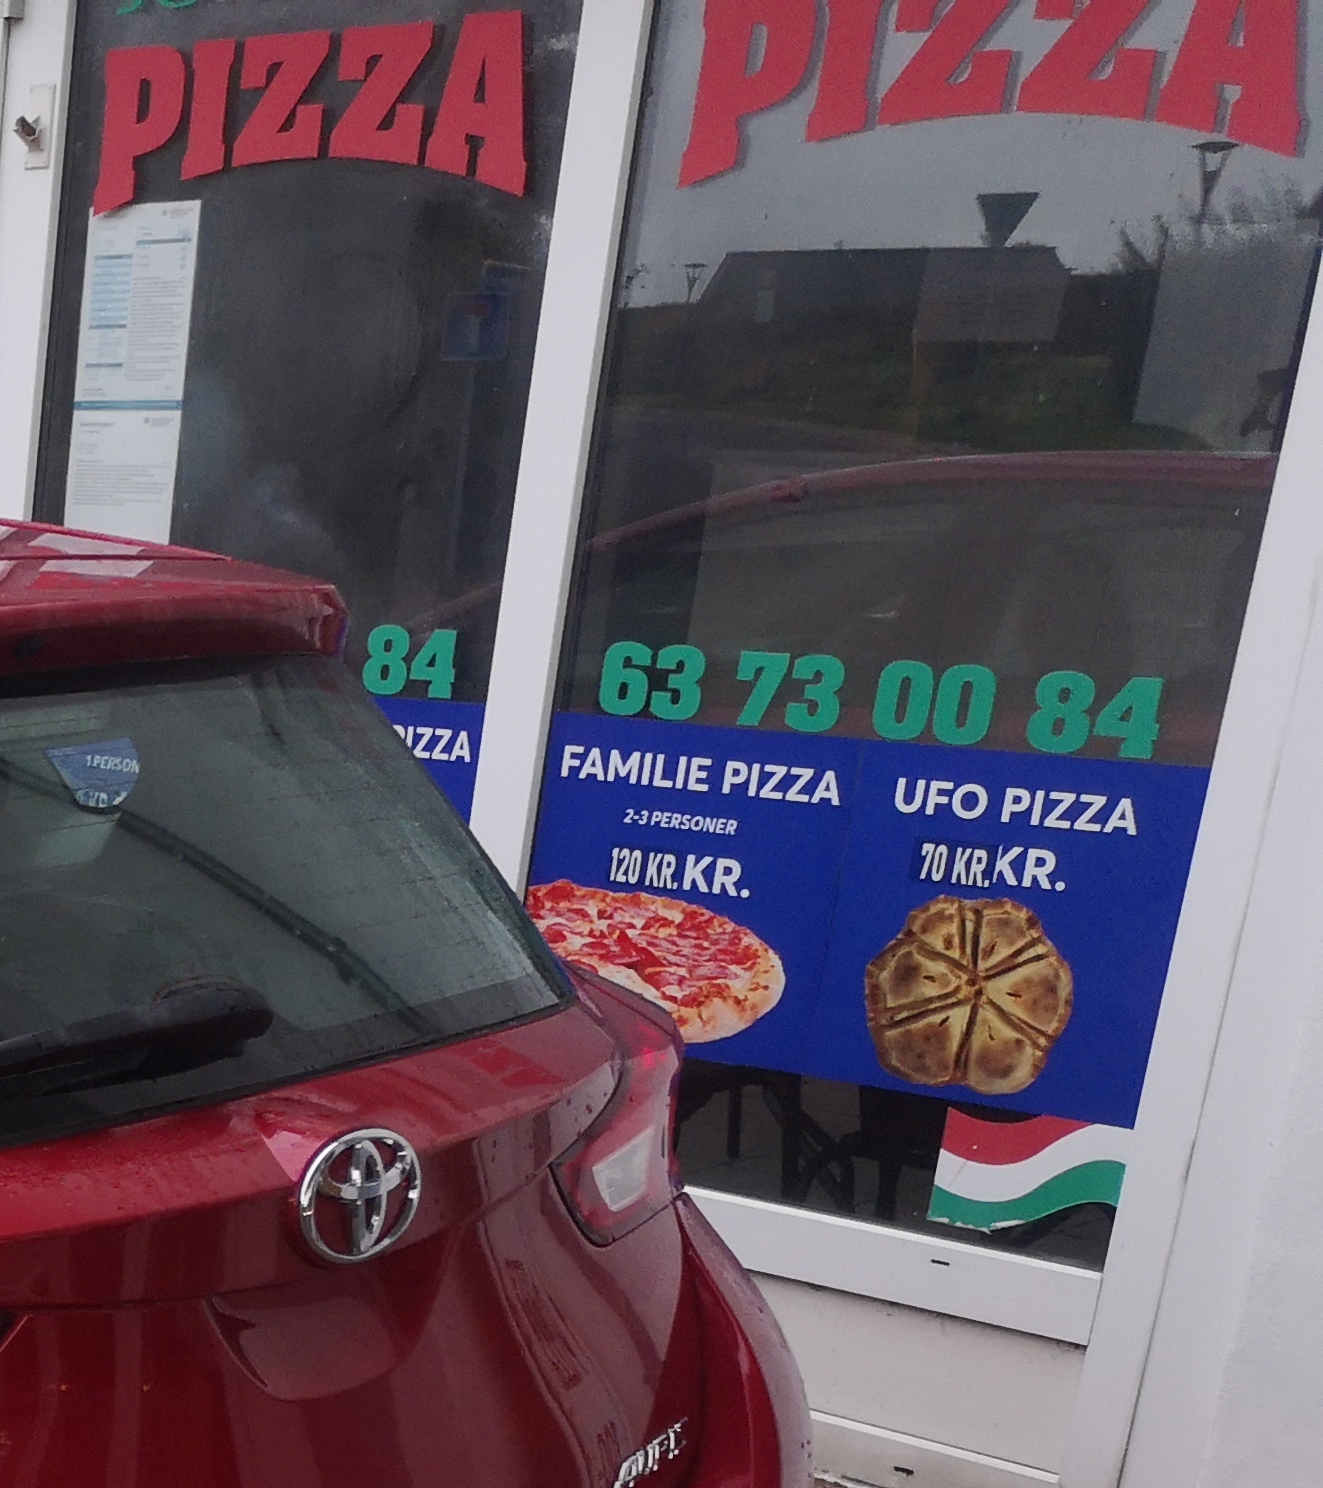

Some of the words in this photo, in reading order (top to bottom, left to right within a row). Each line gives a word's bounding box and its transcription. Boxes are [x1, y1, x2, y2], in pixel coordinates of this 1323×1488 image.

[93, 10, 528, 217] PIZZA
[678, 0, 1299, 190] PIZZA
[362, 624, 457, 699] 84
[598, 641, 706, 722] 63
[735, 650, 846, 733] 73
[872, 659, 997, 746] 00
[1025, 670, 1164, 760] 84
[560, 744, 713, 793] FAMILIE
[721, 760, 841, 806] PIZZA
[623, 809, 649, 826] 2-3
[650, 811, 738, 836] PERSONER
[894, 777, 988, 821] UFO
[1000, 787, 1138, 836] PIZZA
[609, 847, 642, 885] 120
[644, 851, 679, 890] KR.
[682, 854, 751, 899] KR.
[918, 842, 949, 882] 70
[950, 847, 991, 888] KR.
[992, 844, 1067, 892] KR.
